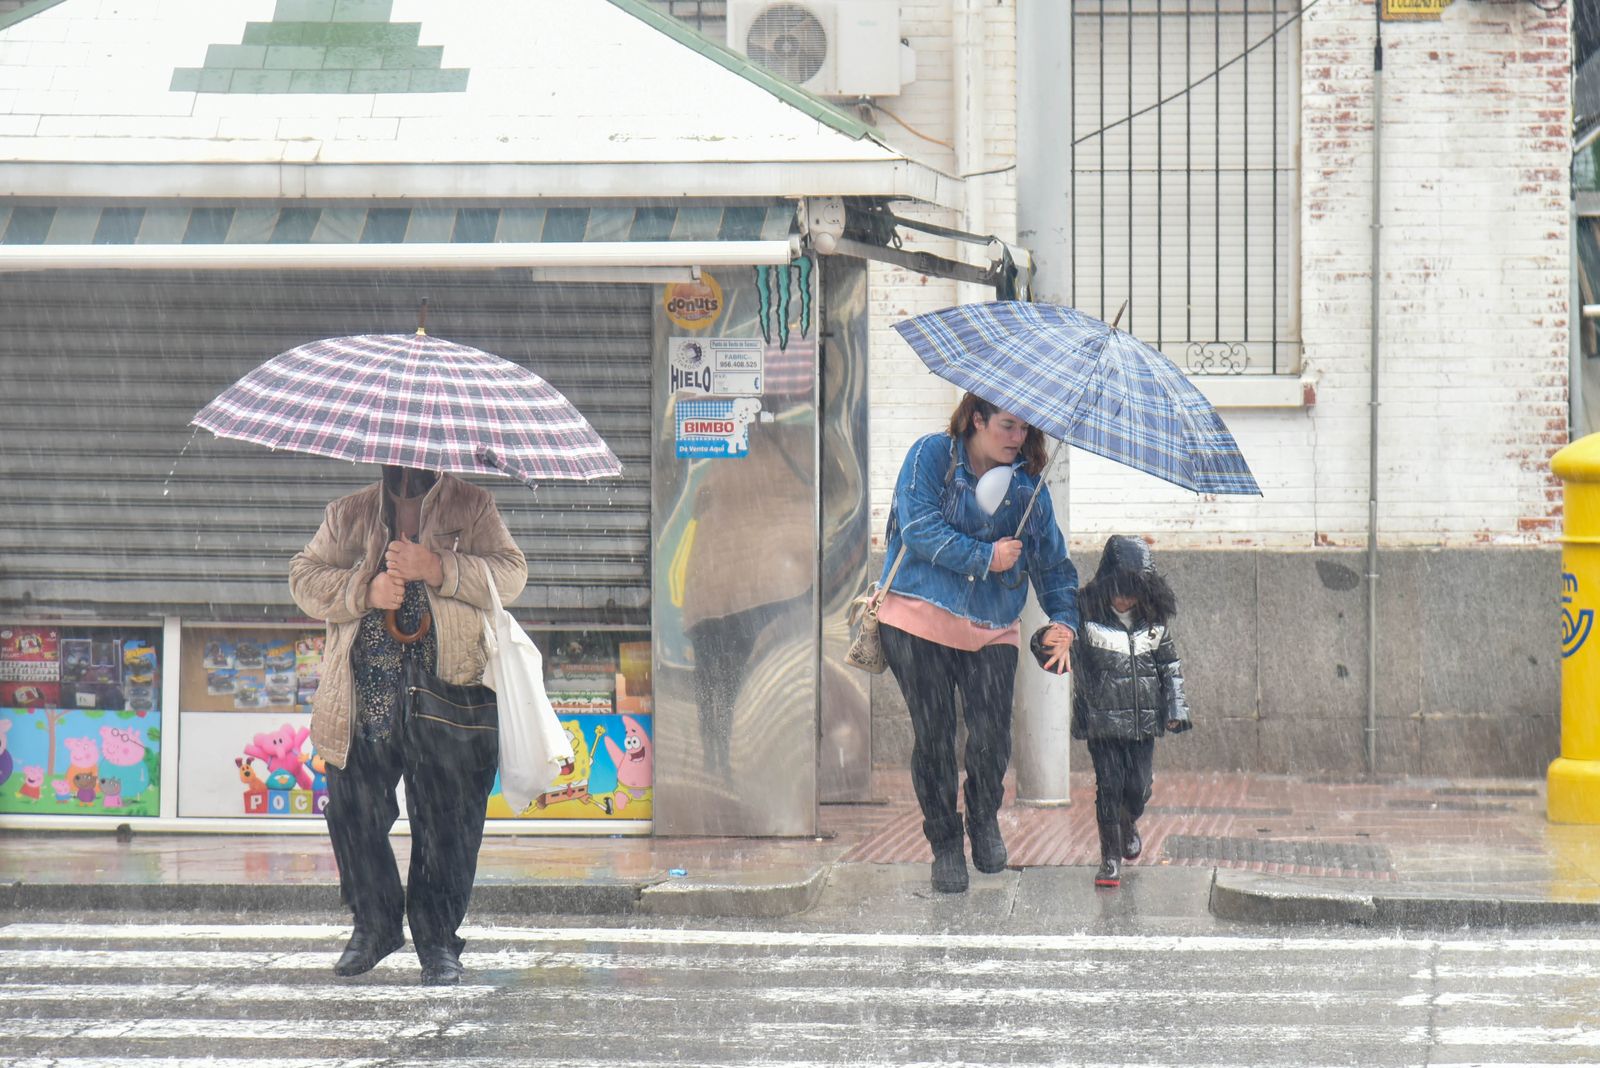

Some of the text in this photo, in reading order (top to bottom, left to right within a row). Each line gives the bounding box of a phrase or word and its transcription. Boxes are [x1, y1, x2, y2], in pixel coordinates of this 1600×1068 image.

[667, 297, 718, 313] donuts
[671, 364, 711, 393] HIELO
[684, 422, 735, 433] BIMBO
